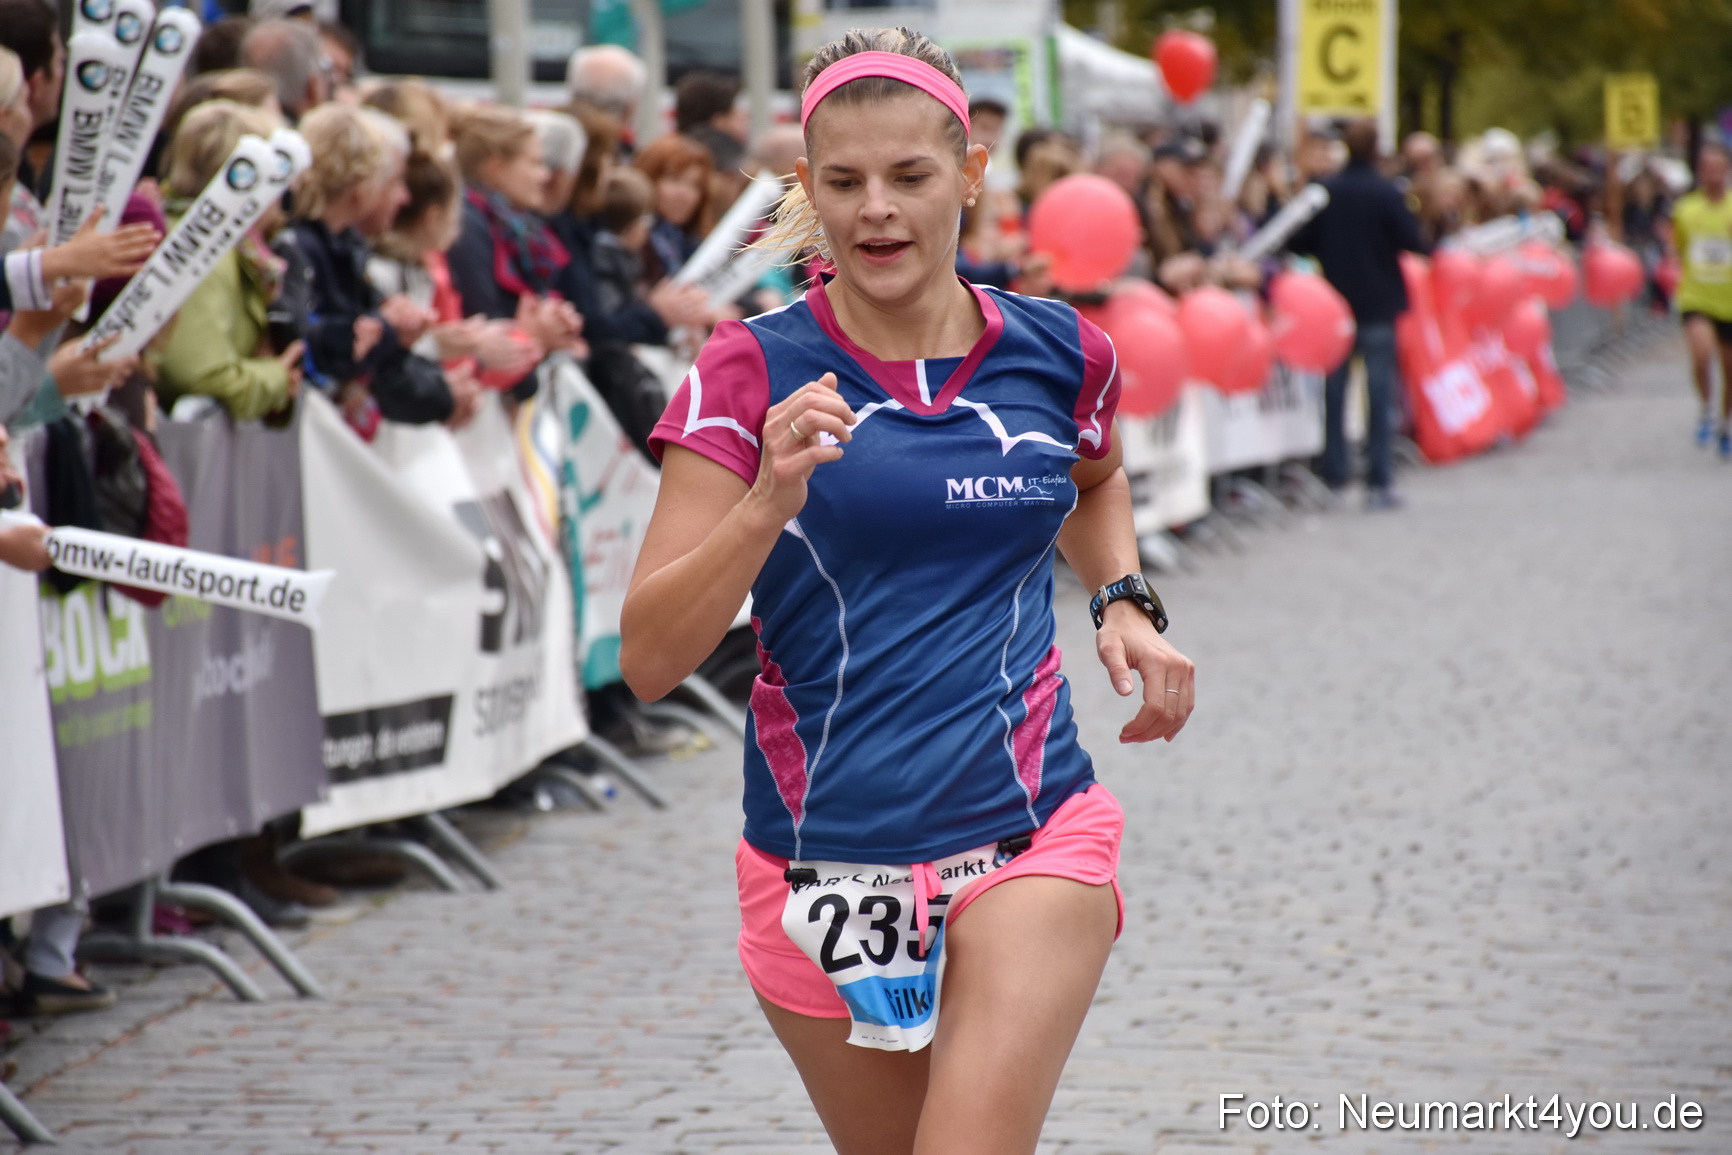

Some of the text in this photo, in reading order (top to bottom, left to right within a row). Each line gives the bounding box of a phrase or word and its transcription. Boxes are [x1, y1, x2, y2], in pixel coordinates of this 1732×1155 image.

[1319, 23, 1362, 84] C
[66, 109, 102, 181] BMW
[117, 74, 163, 152] BMW
[163, 199, 226, 276] BMW
[945, 476, 1024, 500] MCM
[872, 859, 987, 888] Neuarkt
[808, 893, 953, 974] 235
